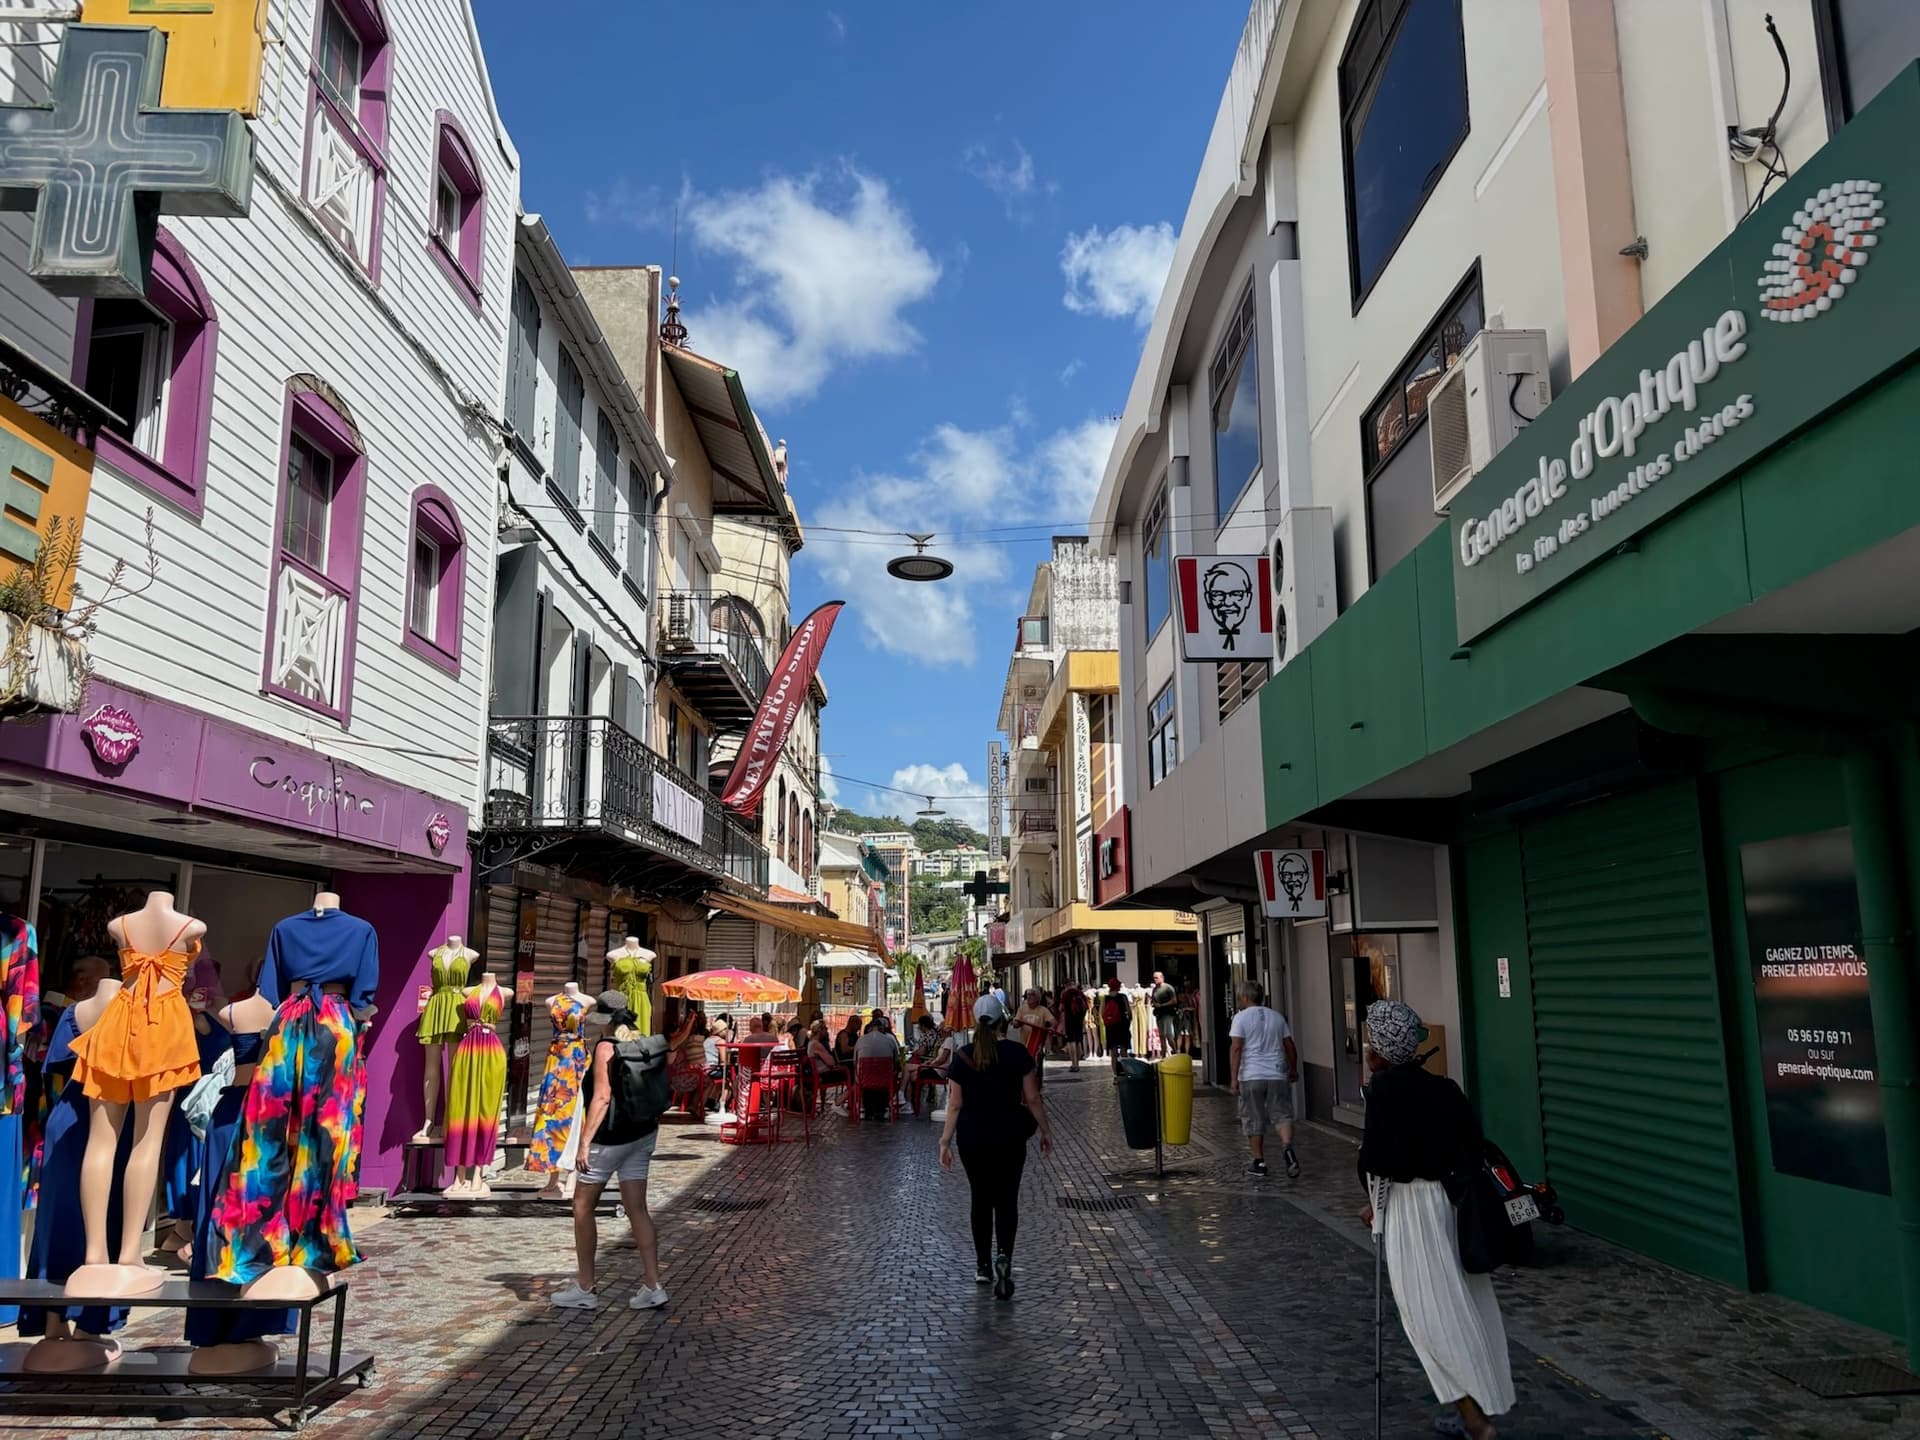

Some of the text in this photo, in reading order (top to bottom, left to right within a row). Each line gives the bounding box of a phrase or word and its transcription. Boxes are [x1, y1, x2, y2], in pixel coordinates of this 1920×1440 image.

[1460, 310, 1747, 566] Generale d'Optique
[1516, 394, 1754, 574] la fin des lunettes chères
[753, 672, 792, 754] TATTOO
[788, 619, 816, 673] SHOP
[249, 756, 375, 816] Coquine
[991, 745, 1001, 857] LABORATOIRE
[1761, 962, 1868, 977] PRENEZ RENDEZ-VOUS
[1766, 944, 1857, 961] GAGNEZ DU TEMPS,
[1787, 1029, 1852, 1045] 05 96 57 69 71
[1777, 1061, 1874, 1081] generale-optique.com
